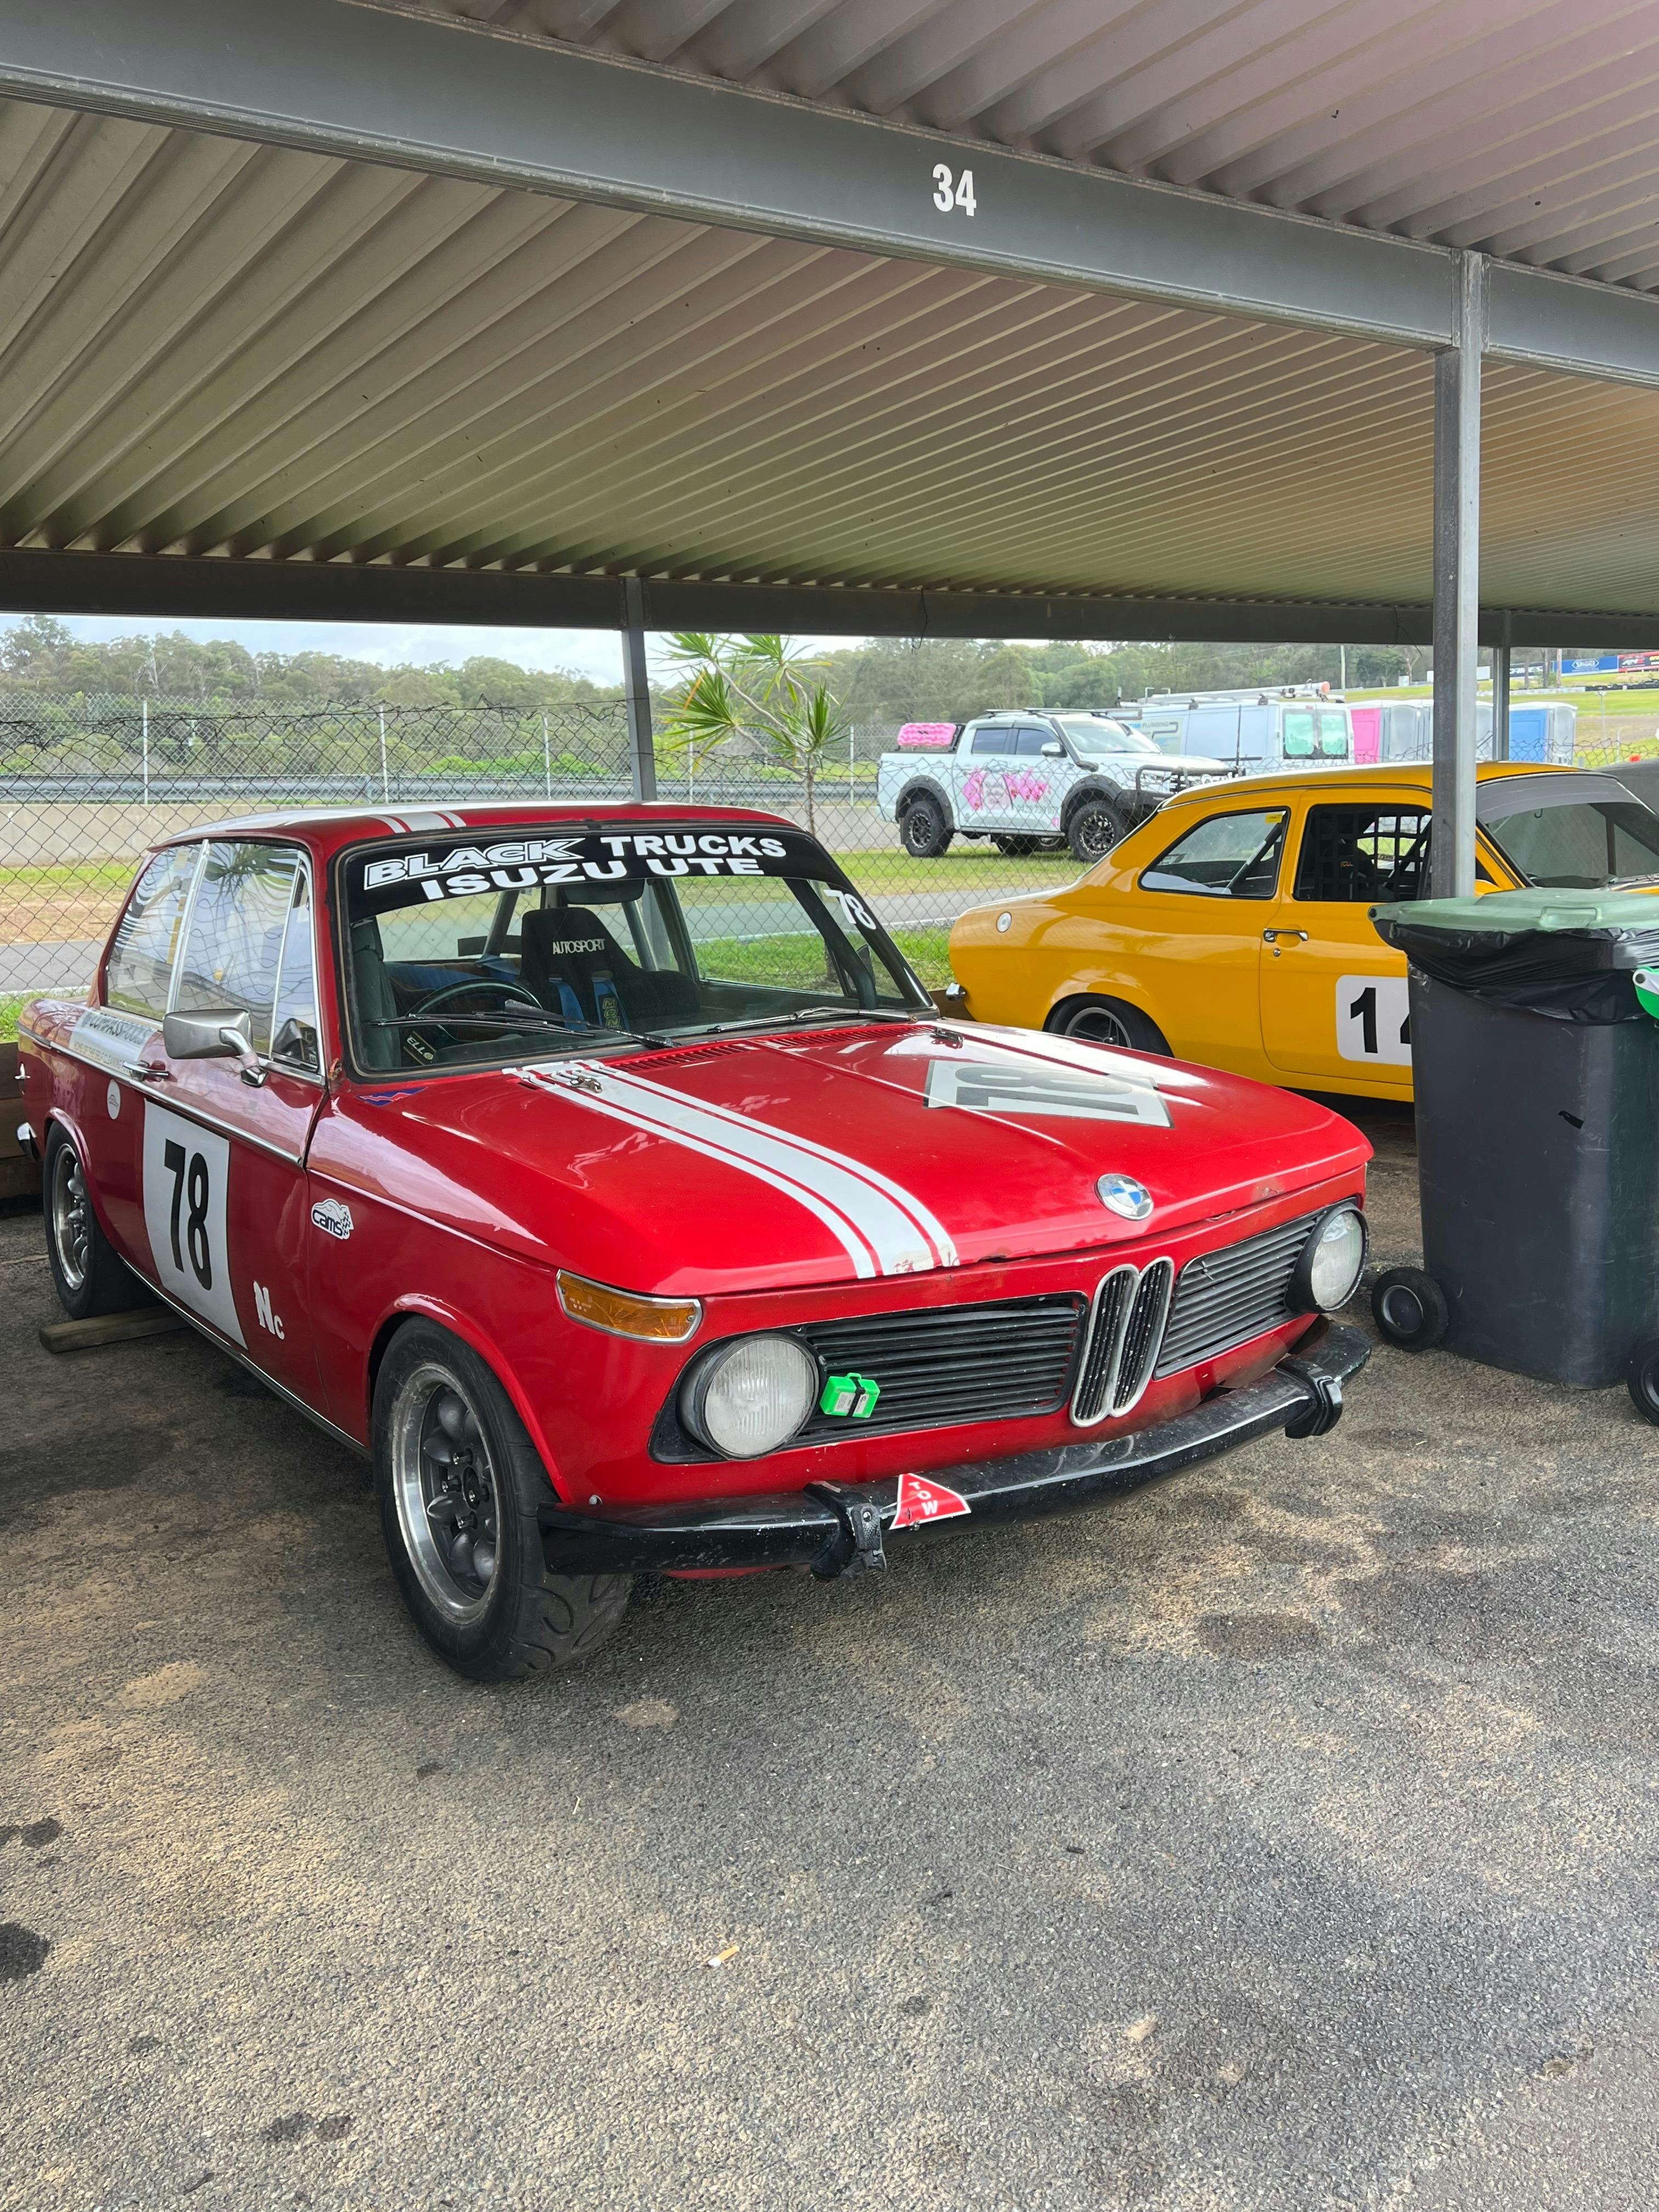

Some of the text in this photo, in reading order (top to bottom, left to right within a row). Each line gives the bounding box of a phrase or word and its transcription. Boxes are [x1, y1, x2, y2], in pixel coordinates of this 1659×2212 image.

[933, 163, 977, 217] 34
[364, 835, 787, 890] BLACK TRUCKS
[420, 857, 765, 900] ISUZU UTE
[823, 889, 877, 930] 78
[553, 939, 606, 955] AUTOSPORT
[955, 1066, 1139, 1115] 78
[164, 1138, 212, 1291] 78
[313, 1209, 343, 1237] cams
[908, 1481, 938, 1516] TOW
